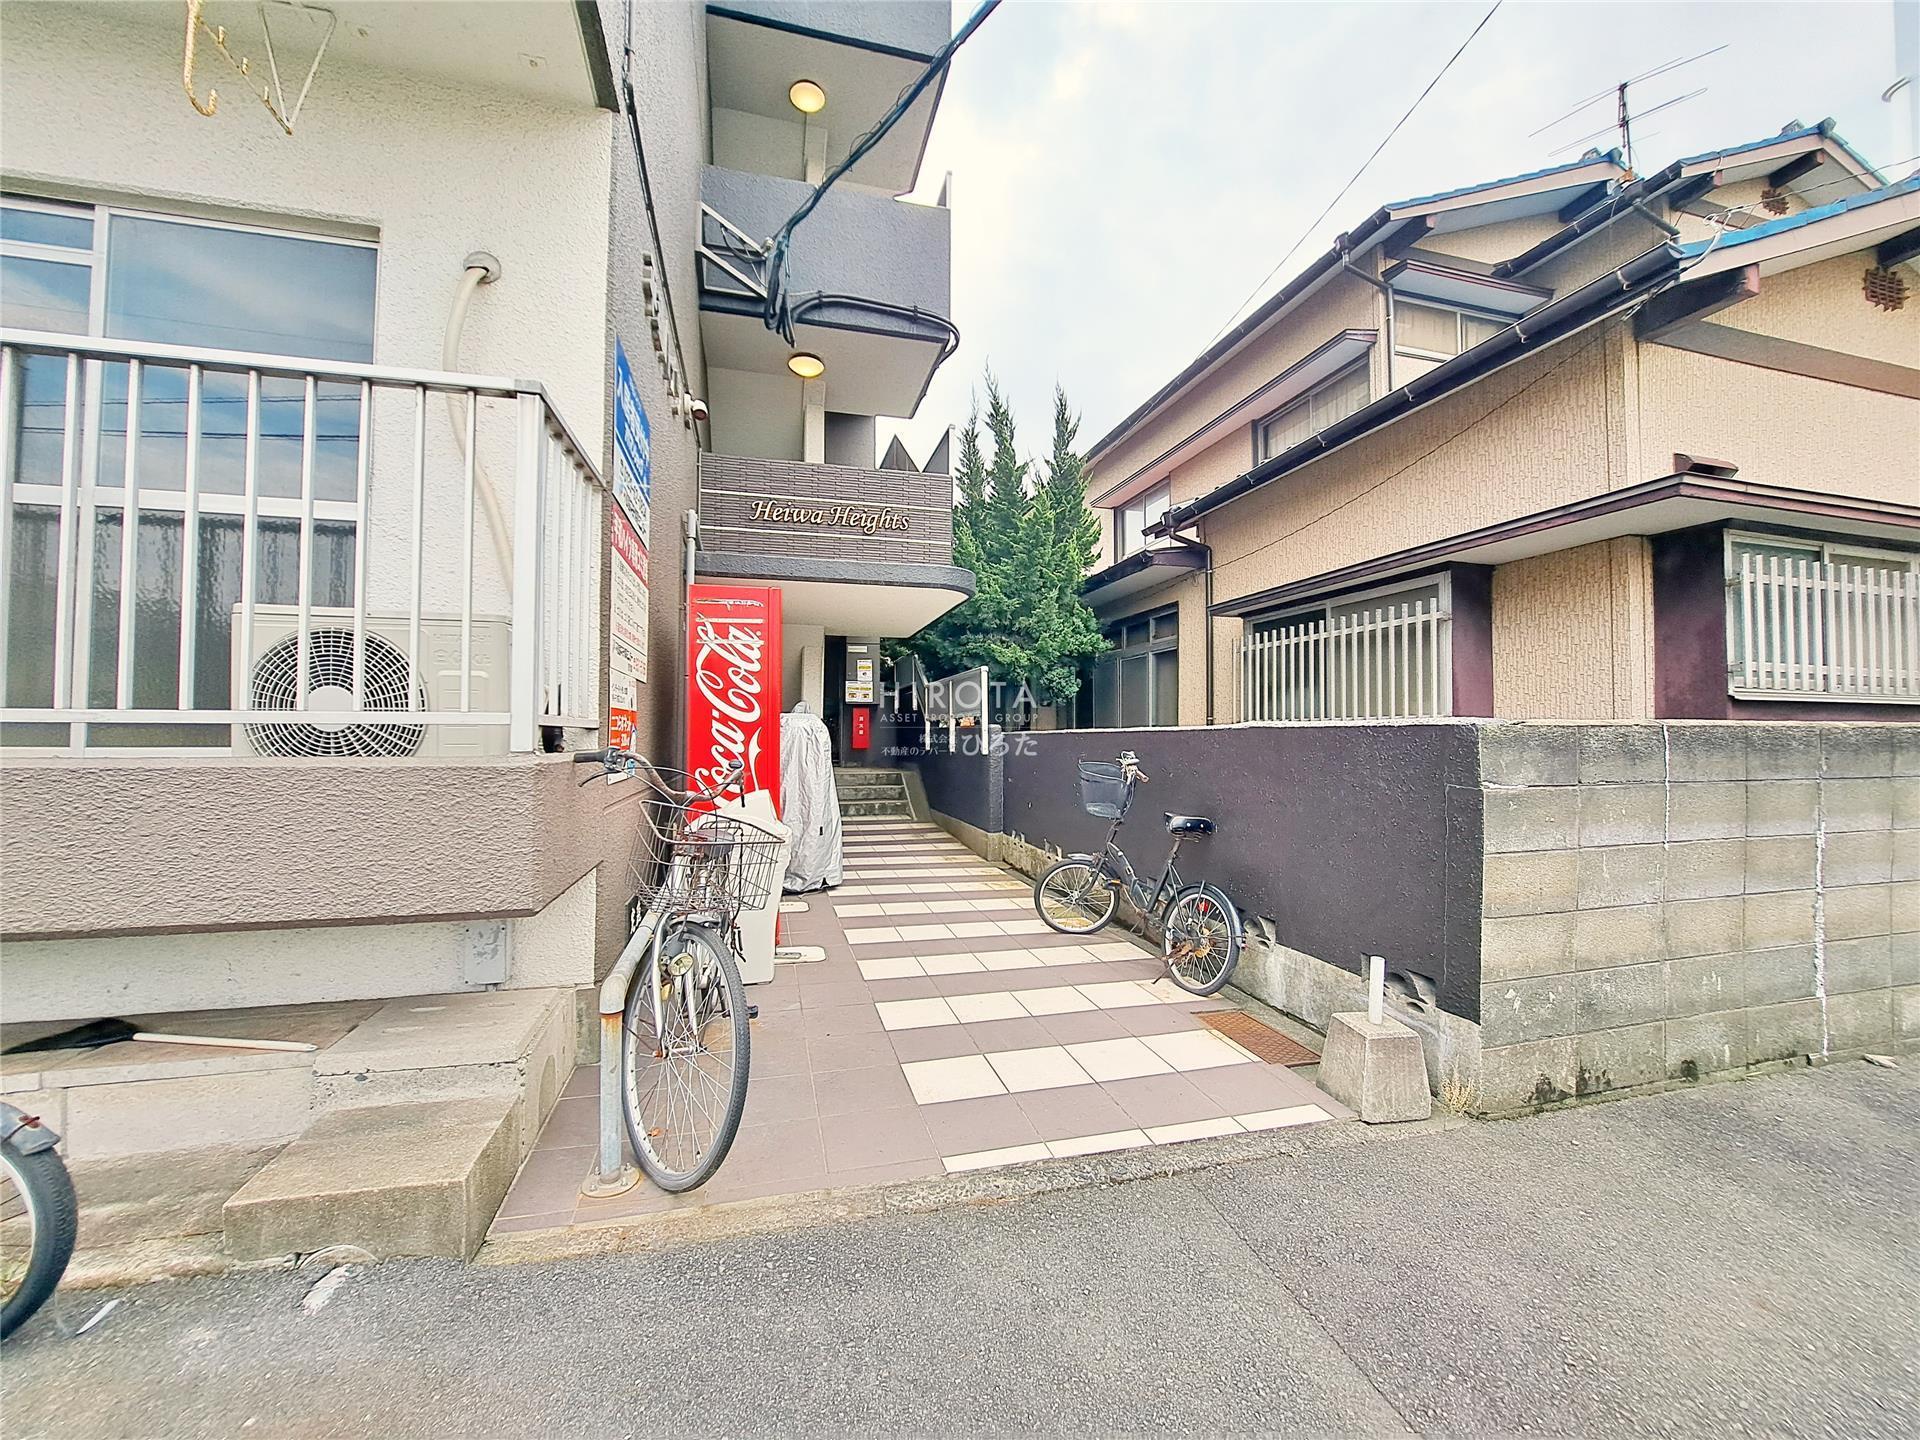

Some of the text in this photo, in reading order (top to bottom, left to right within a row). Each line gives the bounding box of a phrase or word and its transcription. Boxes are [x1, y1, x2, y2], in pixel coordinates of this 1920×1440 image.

[750, 500, 911, 535] Heiwa Heights
[694, 612, 764, 810] Coca-Cola
